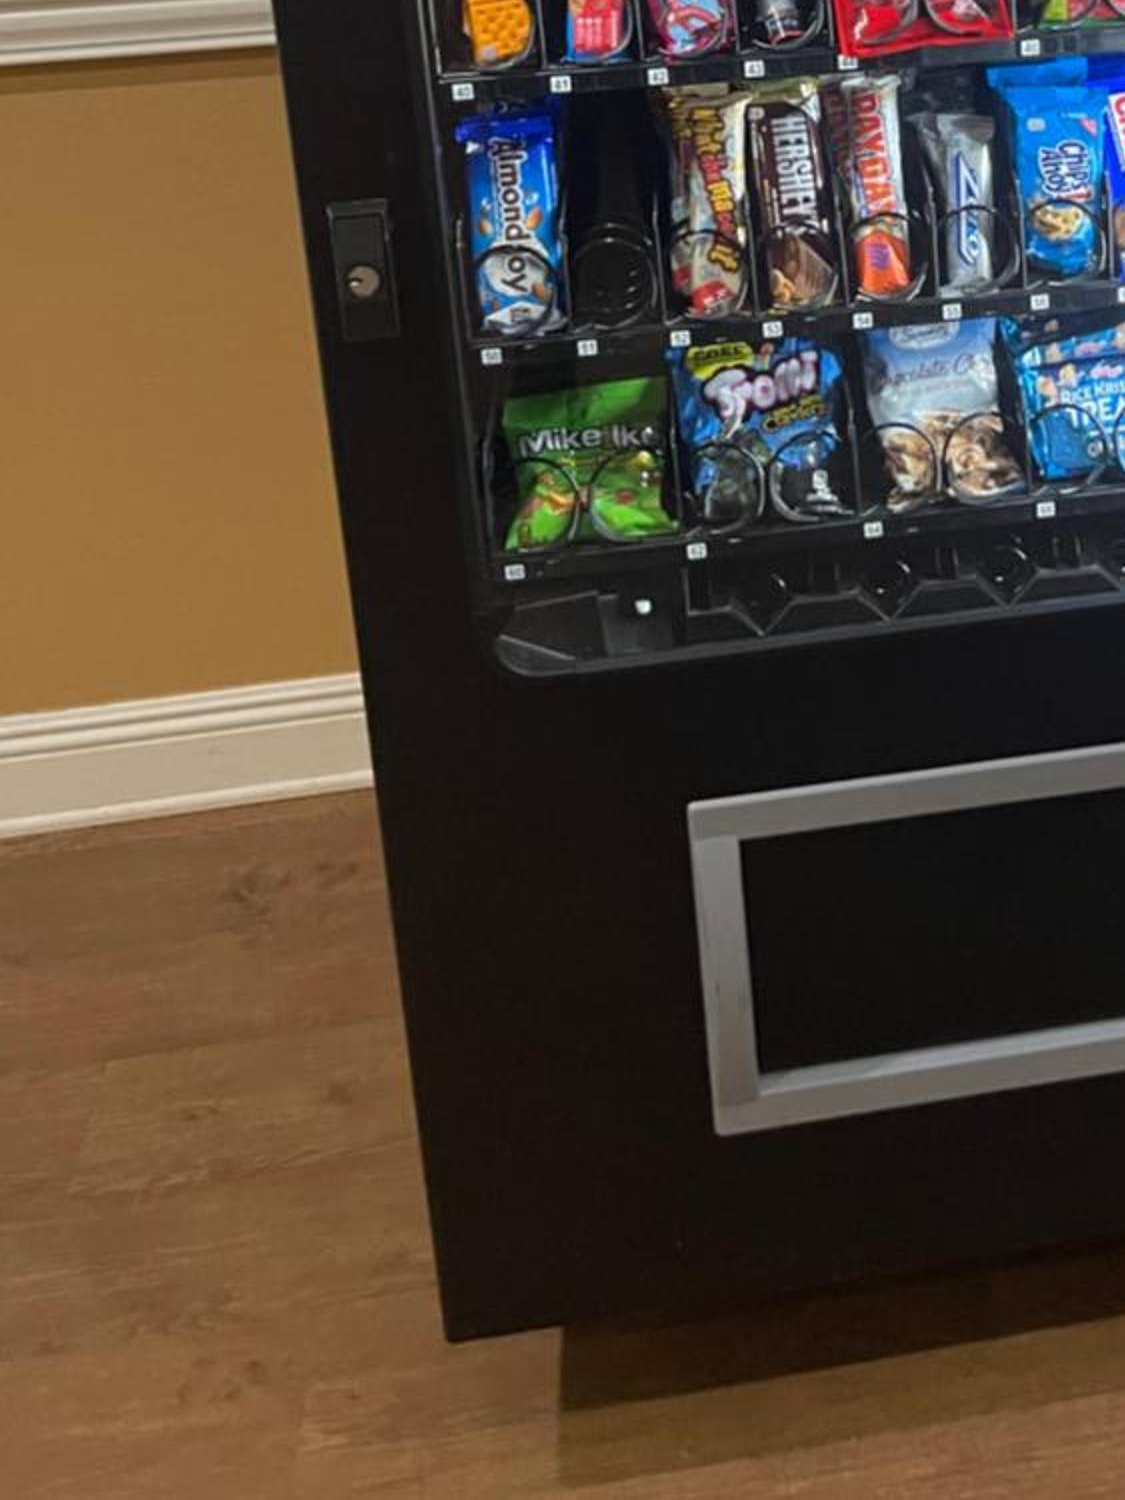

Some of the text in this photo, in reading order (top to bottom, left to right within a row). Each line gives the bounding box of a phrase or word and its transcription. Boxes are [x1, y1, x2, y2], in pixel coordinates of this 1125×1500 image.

[487, 136, 529, 243] Almond
[853, 90, 898, 213] PAYDAY
[519, 424, 602, 458] Mike
